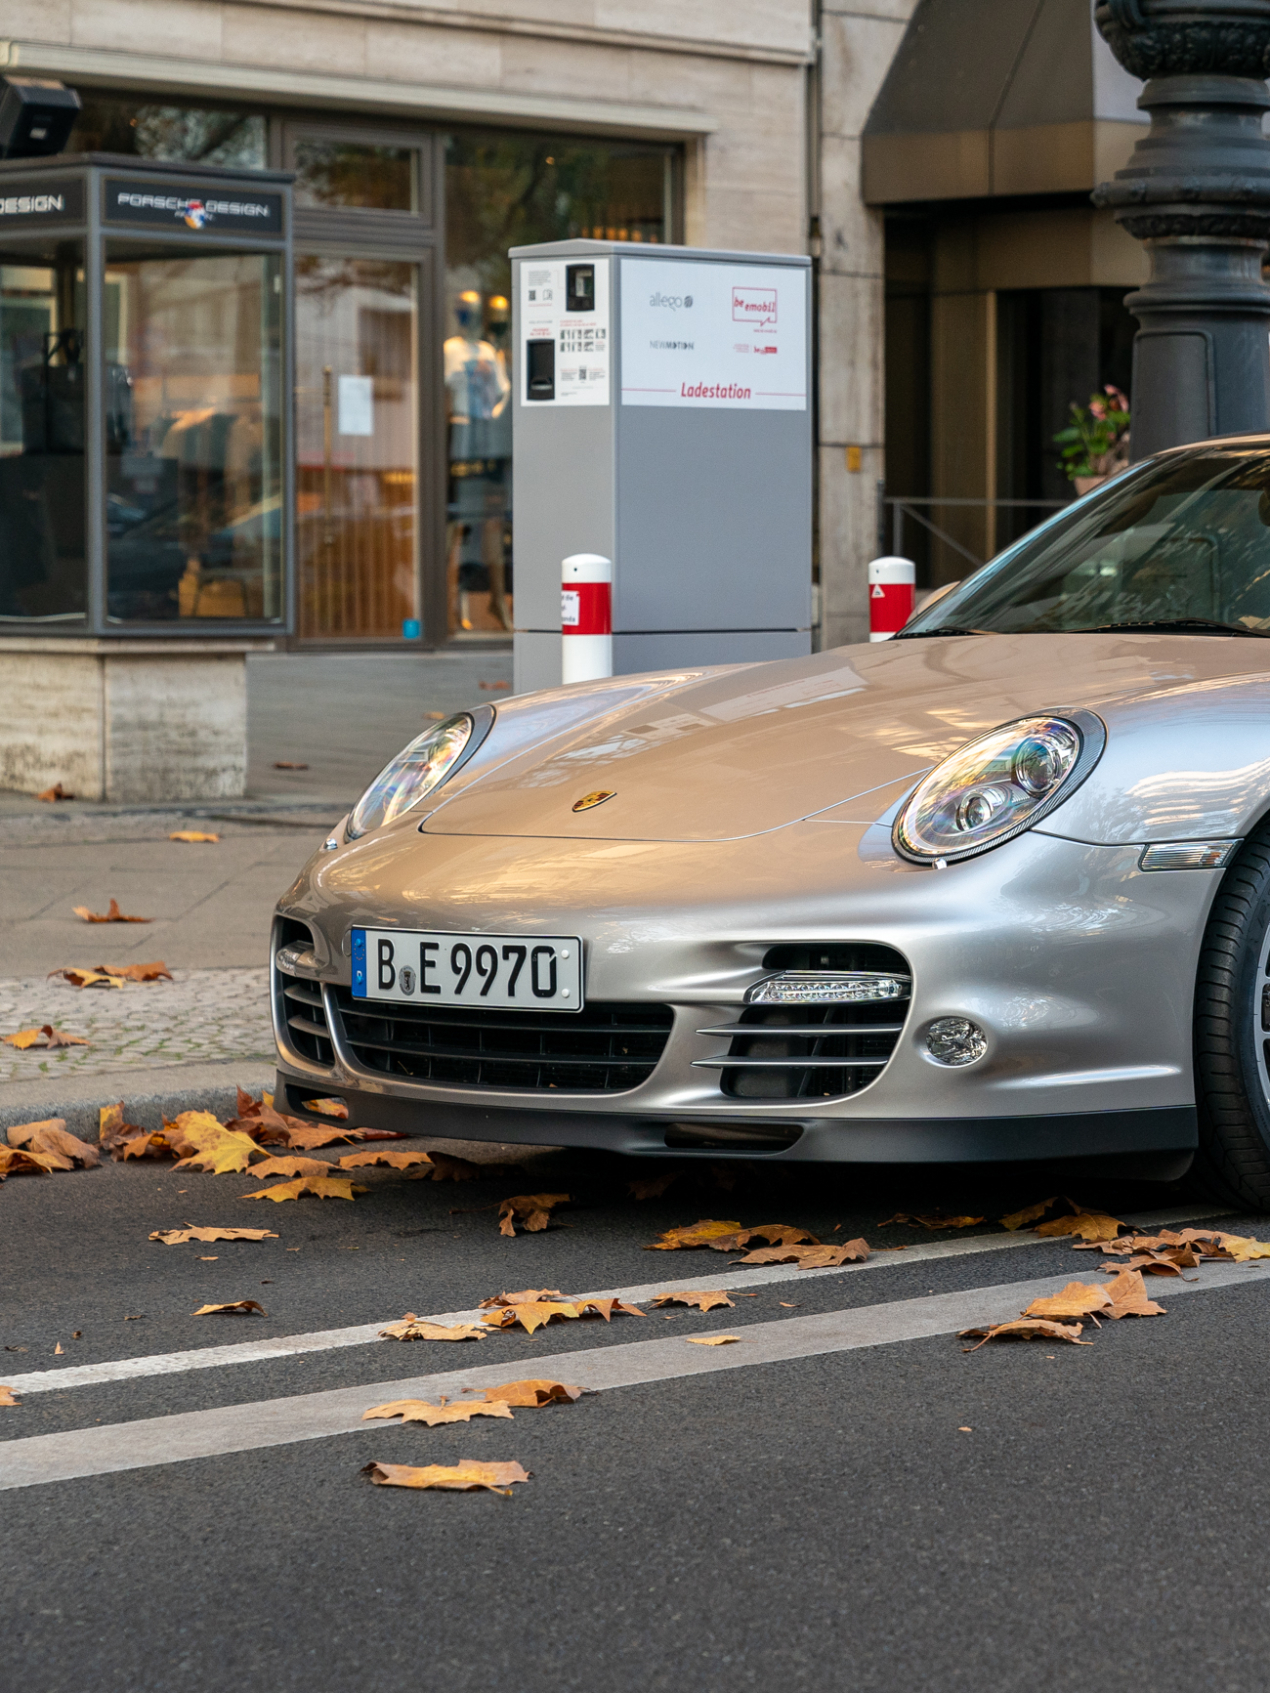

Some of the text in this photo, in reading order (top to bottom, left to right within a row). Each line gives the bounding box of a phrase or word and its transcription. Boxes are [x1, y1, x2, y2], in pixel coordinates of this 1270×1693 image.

[205, 200, 270, 217] DESIGN
[649, 292, 683, 312] allego
[733, 297, 776, 314] be emobil
[680, 382, 752, 400] Ladestation
